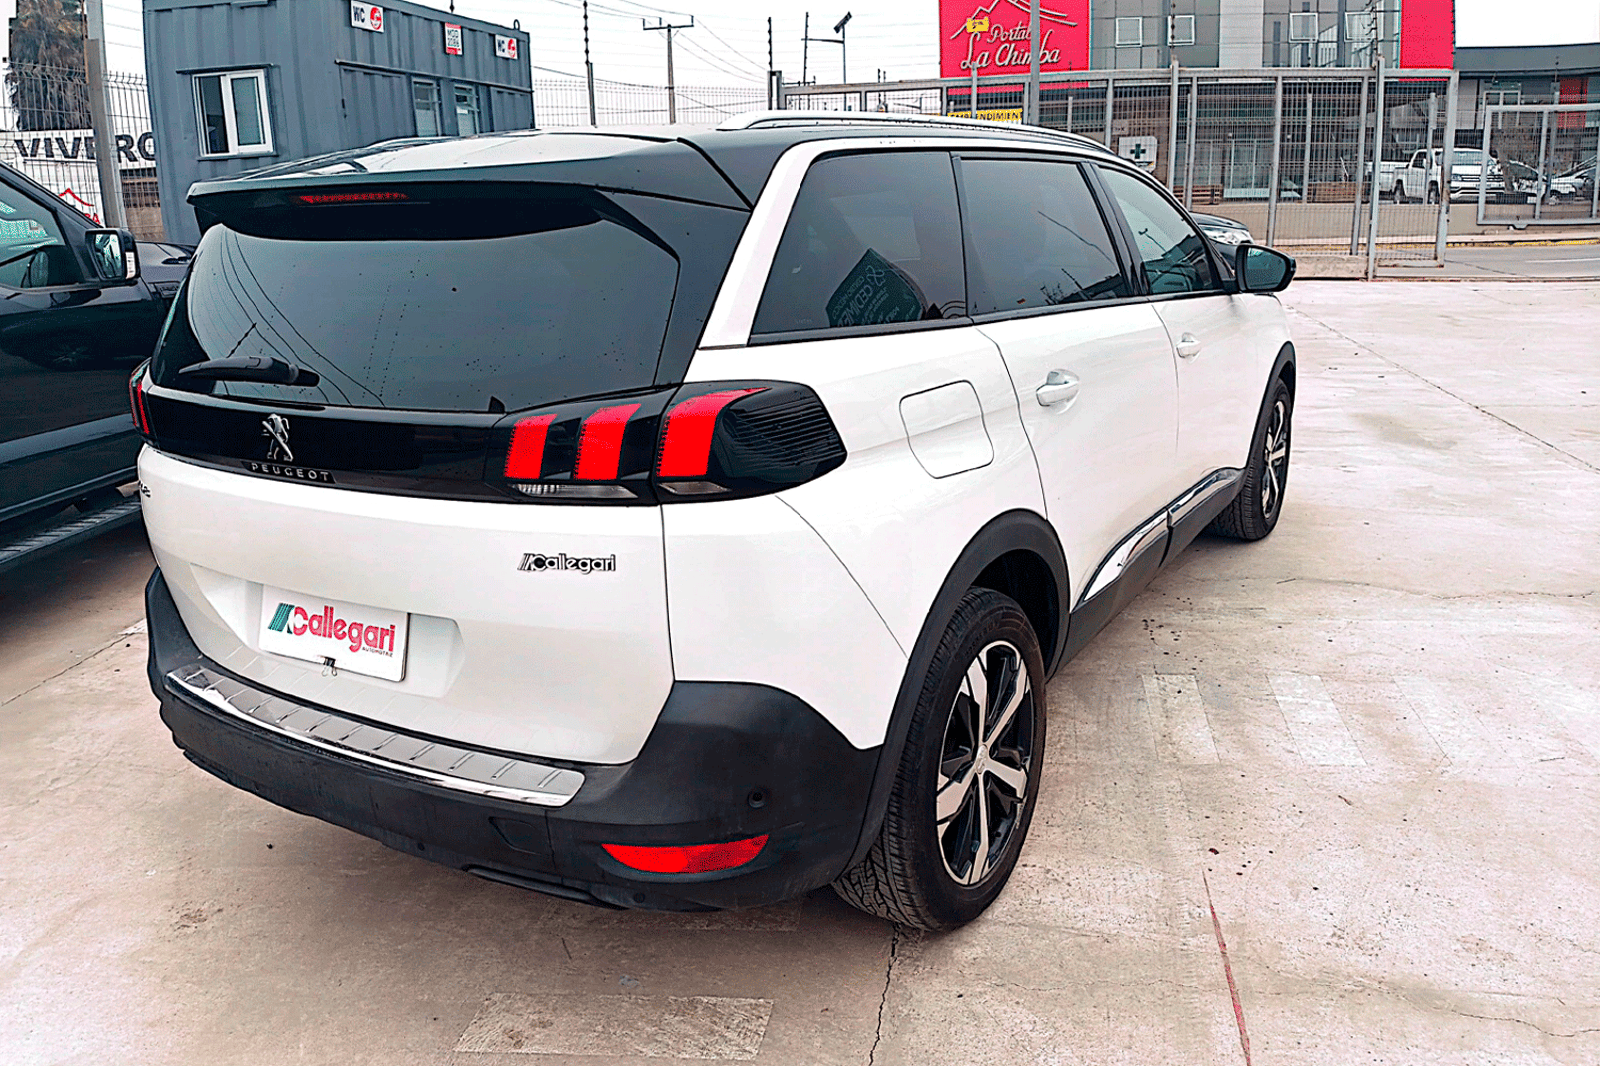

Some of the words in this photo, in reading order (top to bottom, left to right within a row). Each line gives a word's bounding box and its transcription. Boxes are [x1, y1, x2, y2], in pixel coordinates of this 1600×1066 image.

[352, 5, 366, 23] WC
[496, 39, 506, 53] WC
[960, 32, 991, 69] La
[251, 462, 329, 481] PEUGEOT
[532, 553, 616, 575] Callegari
[292, 604, 396, 653] Callegari
